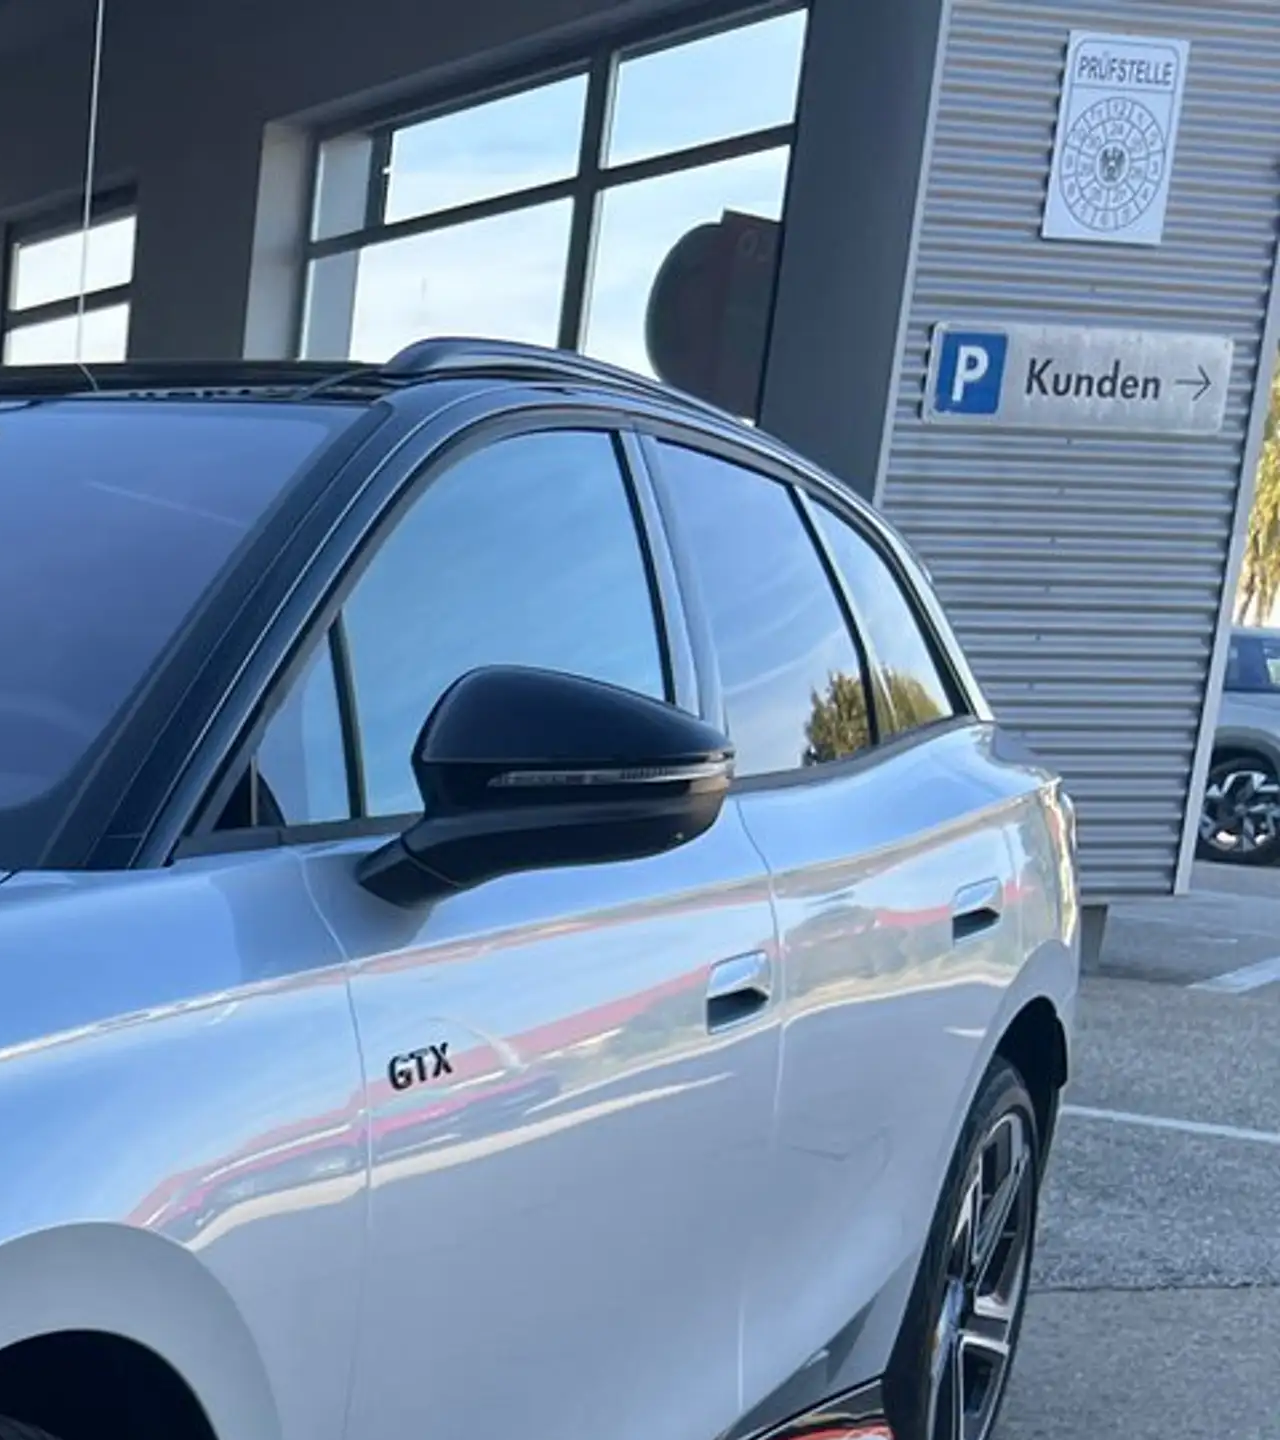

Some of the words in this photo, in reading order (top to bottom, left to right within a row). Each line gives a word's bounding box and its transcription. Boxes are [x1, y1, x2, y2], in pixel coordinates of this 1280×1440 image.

[1078, 52, 1173, 85] PRÜFSTELLE
[951, 345, 989, 402] P
[1024, 357, 1162, 401] Kunden
[388, 1042, 453, 1091] GTX
